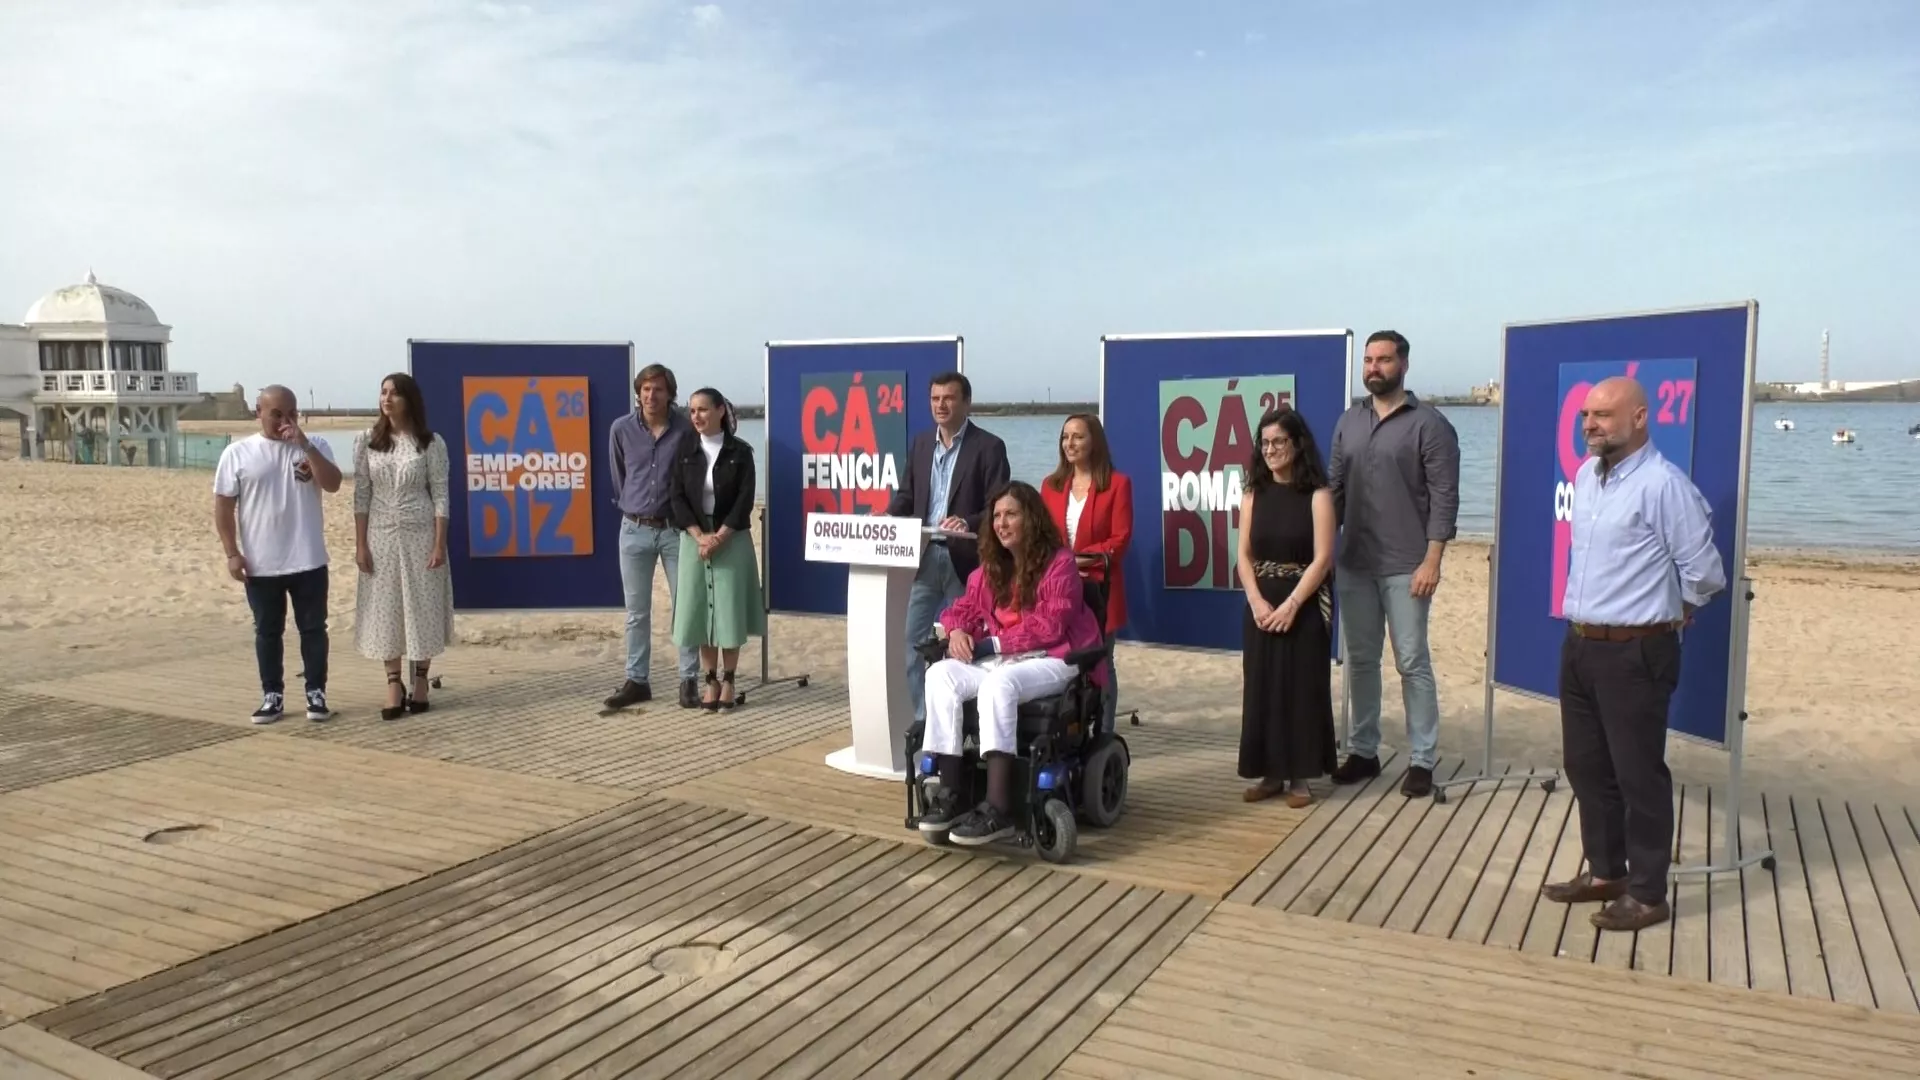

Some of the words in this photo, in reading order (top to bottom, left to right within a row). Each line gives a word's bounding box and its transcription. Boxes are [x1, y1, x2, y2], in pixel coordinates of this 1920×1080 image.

[556, 390, 585, 418] 26
[877, 384, 904, 414] 24
[1657, 379, 1695, 425] 27
[467, 452, 587, 474] EMPORIO
[802, 452, 900, 491] FENICIA
[467, 473, 515, 491] DEL
[518, 472, 586, 491] ORBE
[470, 487, 576, 556] DIZ
[813, 520, 898, 541] ORGULLOSOS
[875, 544, 915, 558] HISTORIA
